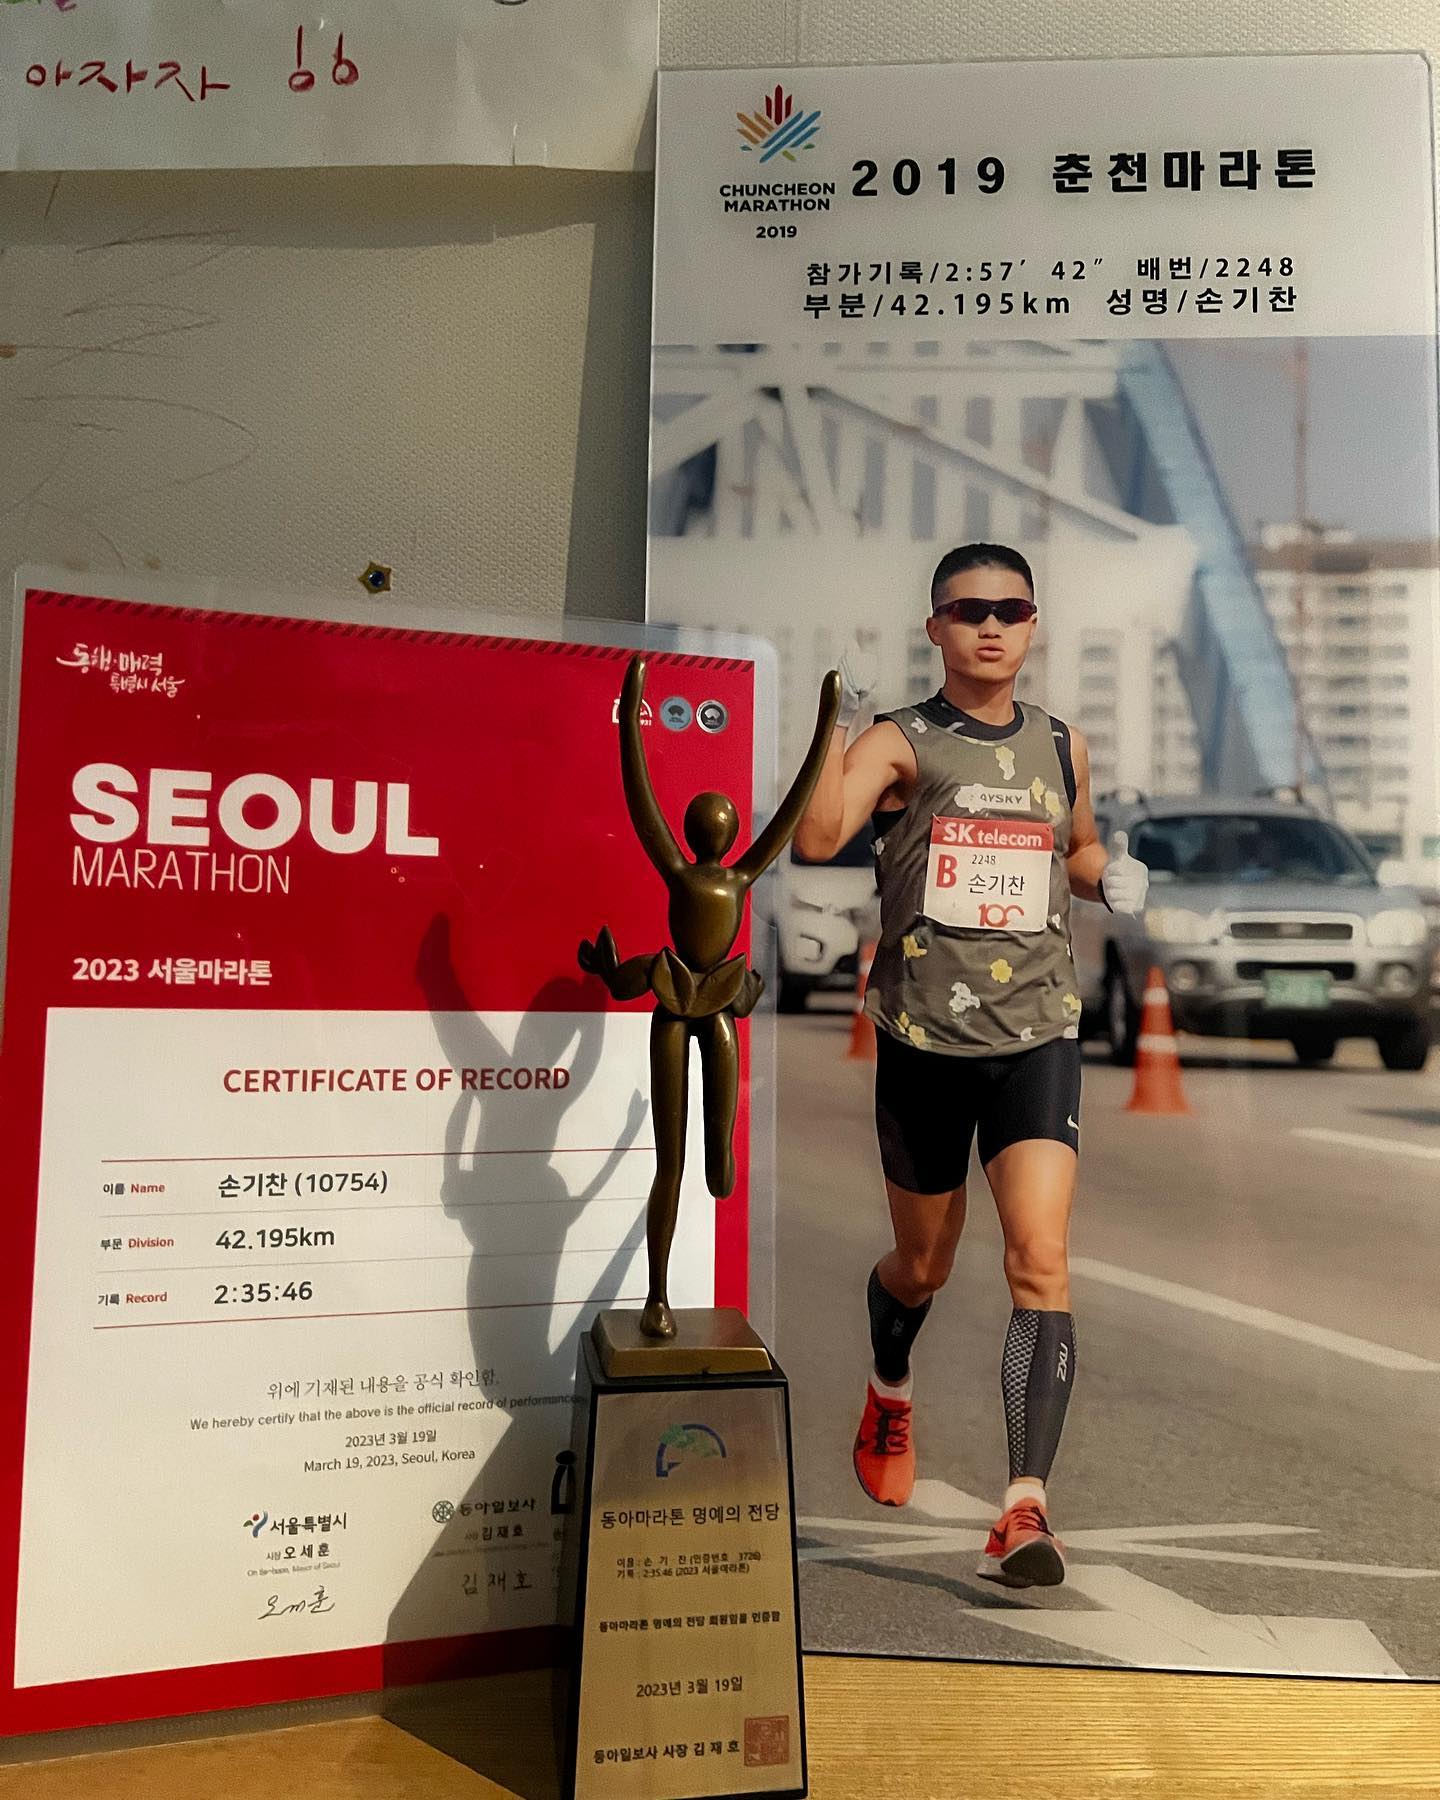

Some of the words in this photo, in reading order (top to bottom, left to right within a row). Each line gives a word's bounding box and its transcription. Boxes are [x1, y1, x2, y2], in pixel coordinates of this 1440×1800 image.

[25, 60, 231, 102] 아자자
[851, 157, 1007, 197] 2019
[1051, 148, 1318, 194] 춘천마라톤
[719, 183, 836, 198] CHUNCHEON
[723, 197, 831, 213] MARATHON
[755, 225, 798, 239] 2019
[69, 762, 440, 858] SEOUL
[942, 821, 976, 845] SK
[977, 828, 1042, 848] telecom
[72, 845, 291, 895] MARATHON
[935, 853, 959, 889] B
[971, 854, 997, 866] 2248
[967, 873, 1025, 897] 손기찬
[72, 956, 140, 983] 2023
[147, 957, 273, 986] 서울마라톤
[223, 1067, 408, 1094] CERTIFICATE
[415, 1068, 455, 1092] OF
[460, 1066, 571, 1091] RECORD
[102, 1182, 126, 1196] 이름
[130, 1182, 166, 1194] Name
[217, 1171, 288, 1199] 손기찬
[294, 1170, 389, 1197] (10754)
[100, 1238, 123, 1251] 부문
[128, 1236, 175, 1249] Division
[215, 1226, 336, 1251] 42.195km
[97, 1293, 120, 1306] 기록
[125, 1291, 168, 1305] Record
[213, 1281, 314, 1305] 2:35:46
[266, 1381, 301, 1400] 위에
[305, 1378, 355, 1398] 기재된
[360, 1374, 409, 1395] 내용을
[413, 1371, 445, 1391] 공식
[190, 1418, 209, 1431] We
[211, 1415, 255, 1430] hereby
[258, 1412, 296, 1427] certify
[298, 1410, 322, 1422] that
[324, 1408, 343, 1420] the
[345, 1406, 381, 1419] above
[384, 1404, 394, 1416] is
[396, 1403, 415, 1416] the
[417, 1401, 455, 1415] official
[457, 1399, 494, 1412] record
[496, 1398, 508, 1410] of
[345, 1431, 386, 1449] 2023년
[388, 1431, 408, 1446] 3월
[411, 1428, 438, 1444] 19일
[303, 1457, 342, 1473] March
[344, 1456, 364, 1471] 19,
[365, 1454, 399, 1470] 2023,
[401, 1450, 439, 1466] Seoul,
[441, 1448, 476, 1463] Korea
[270, 1511, 348, 1536] 서울특별시
[600, 1508, 685, 1530] 동아마라톤
[692, 1505, 741, 1525] 명예의
[747, 1502, 781, 1523] 전당
[635, 1680, 682, 1698] 2023년
[686, 1678, 709, 1695] 3월
[714, 1675, 744, 1693] 19일
[592, 1746, 659, 1765] 동아일보사
